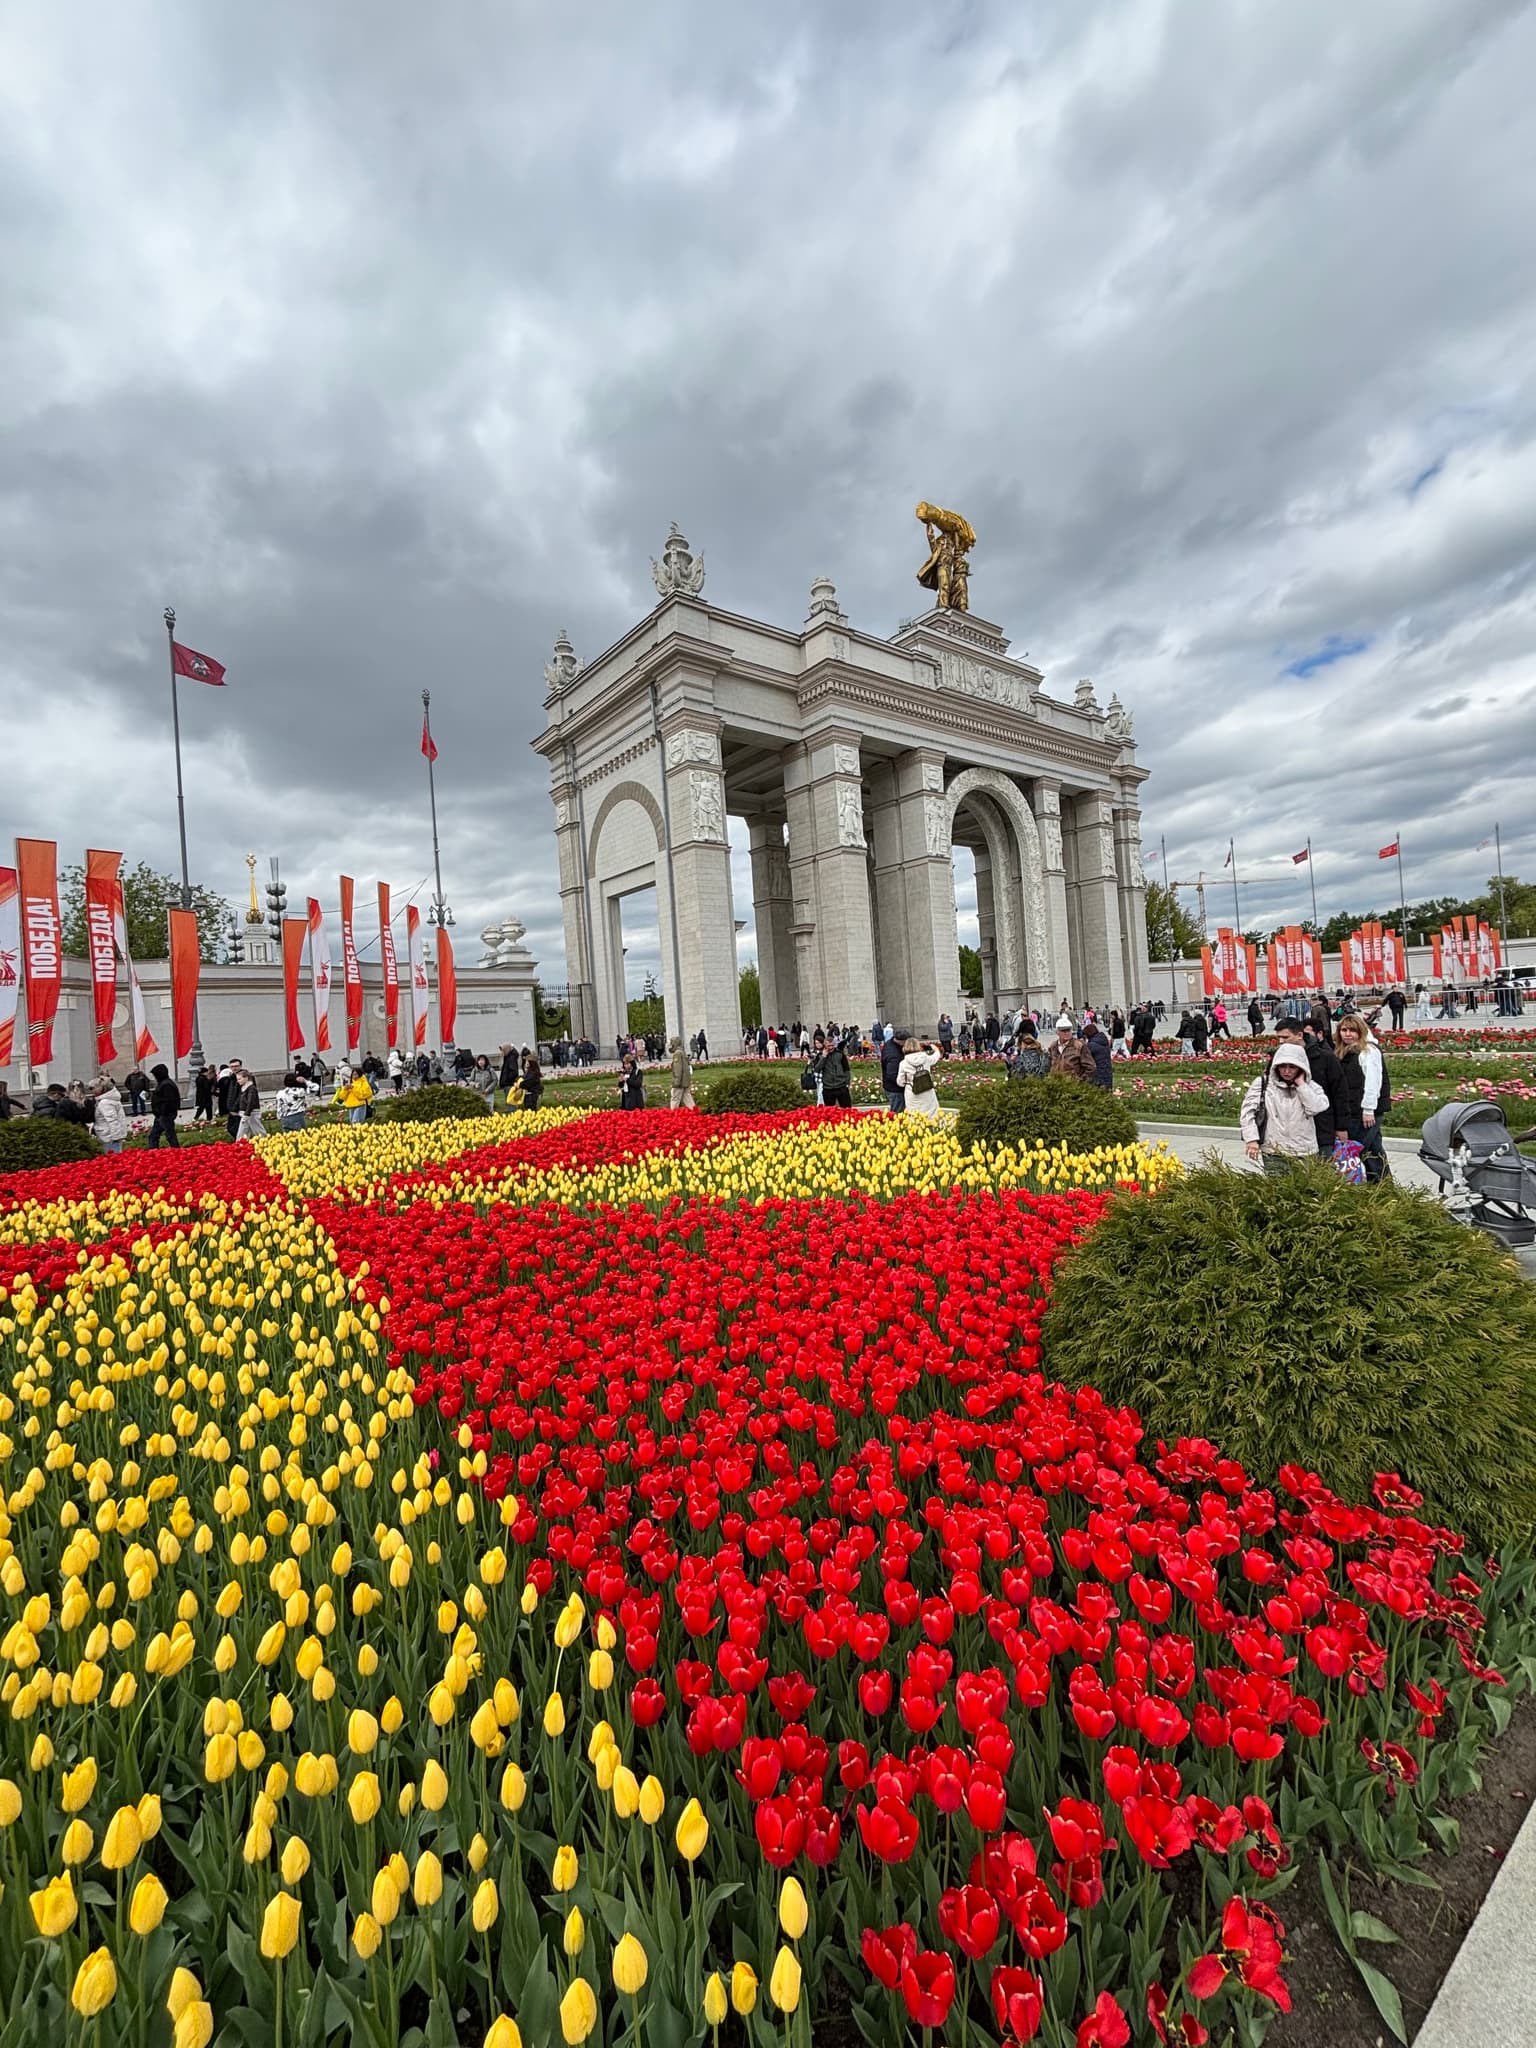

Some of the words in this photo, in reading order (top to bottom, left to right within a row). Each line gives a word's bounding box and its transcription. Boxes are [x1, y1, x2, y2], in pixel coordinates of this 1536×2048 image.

[26, 897, 58, 979] ПОБЕДА!
[88, 903, 115, 982] ПОБЕДА!
[344, 920, 360, 984] ПОБЕДА!
[384, 925, 398, 985] ПОБЕДА!
